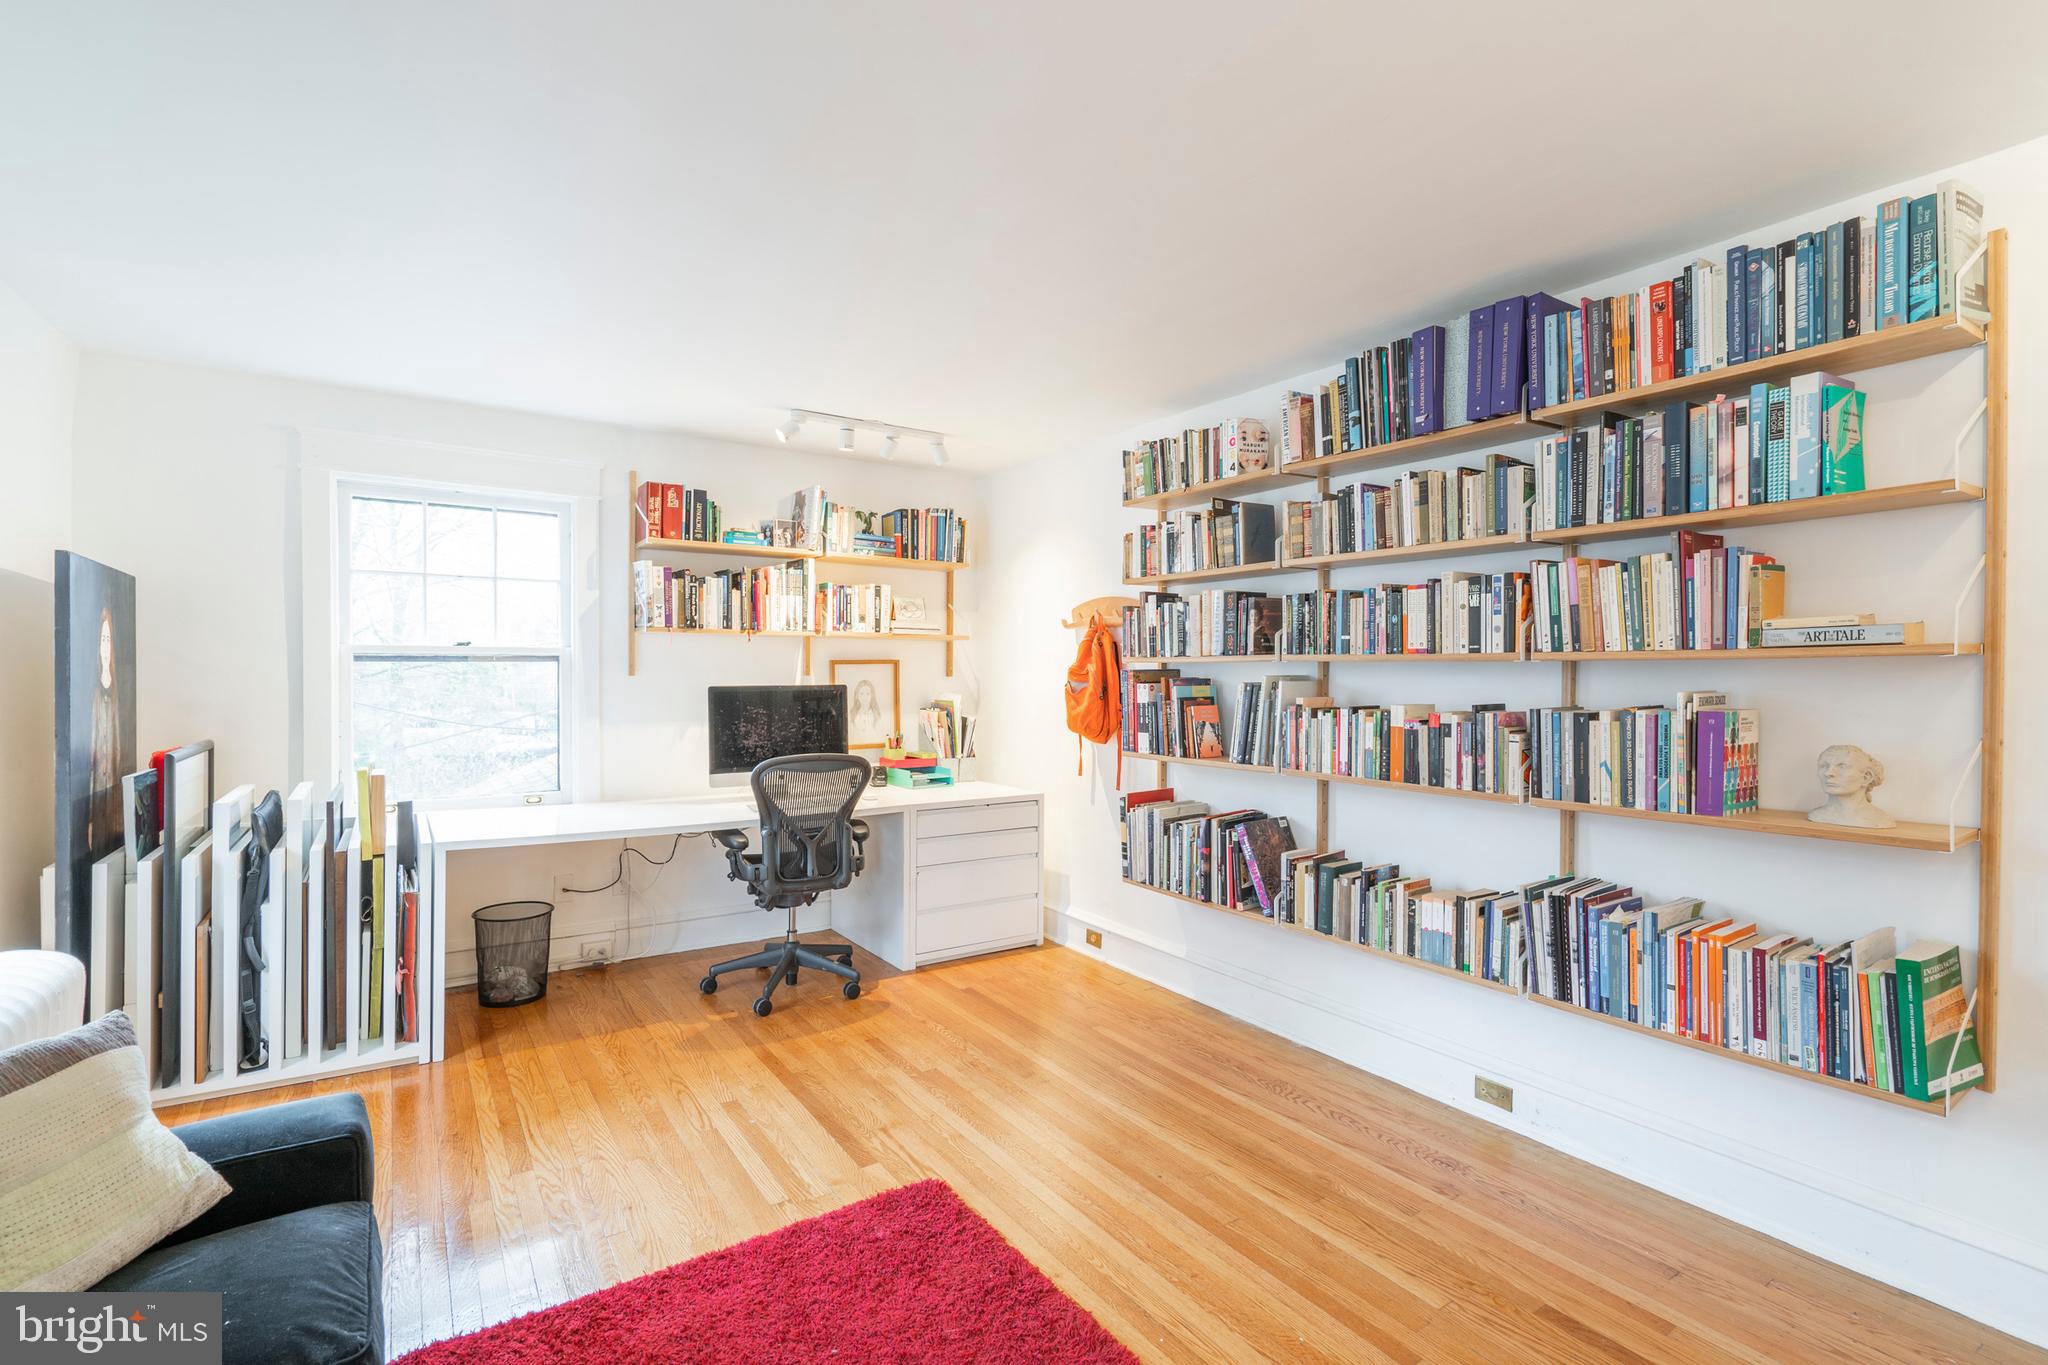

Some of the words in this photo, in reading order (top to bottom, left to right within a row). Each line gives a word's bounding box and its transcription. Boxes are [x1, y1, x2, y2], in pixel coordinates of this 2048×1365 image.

[1885, 222, 1899, 283] MICROECONOMIC
[1923, 229, 1934, 261] Recursive
[1885, 284, 1899, 314] THEORY
[1530, 314, 1538, 329] NEW
[1591, 307, 1599, 324] LABOR
[1656, 315, 1665, 362] UNEMPLOYMENT
[1282, 408, 1290, 437] AMERICAN
[1770, 410, 1778, 434] THEORY
[1777, 410, 1785, 431] GAME
[1283, 438, 1291, 450] DIRT
[1752, 421, 1761, 458] Computational
[1652, 443, 1660, 493] ECONOMETRIC
[694, 502, 704, 530] DICTIONARY
[1804, 631, 1828, 643] ART
[1834, 628, 1866, 642] TALE
[1626, 740, 1632, 748] DE
[1791, 986, 1799, 1005] POLICY
